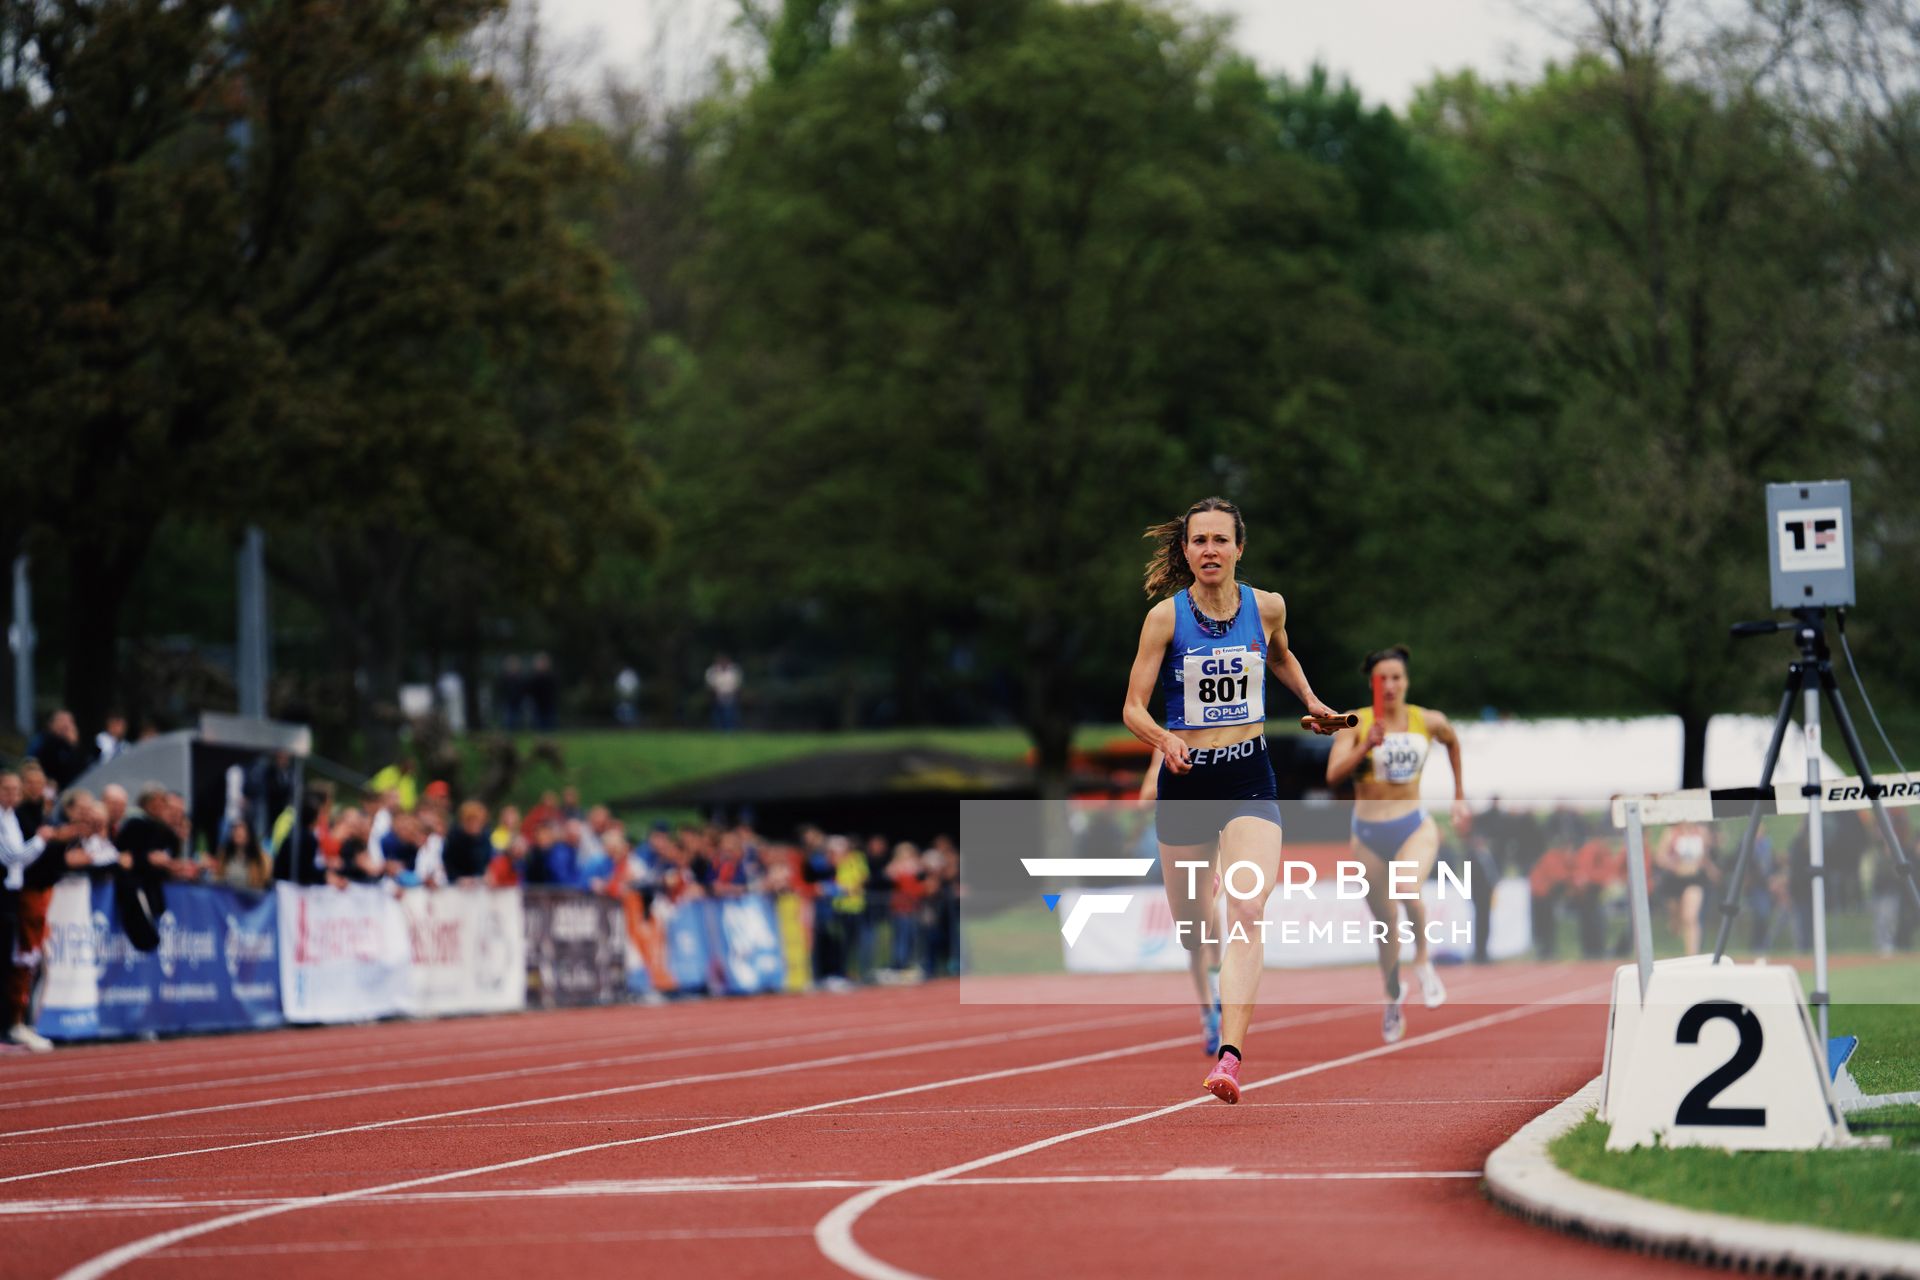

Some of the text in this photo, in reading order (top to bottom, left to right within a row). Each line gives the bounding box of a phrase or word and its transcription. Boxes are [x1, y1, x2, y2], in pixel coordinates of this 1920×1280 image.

[1199, 675, 1248, 703] 801
[1222, 705, 1247, 716] PLAN
[1212, 740, 1254, 764] PRO
[1675, 999, 1766, 1127] 2
